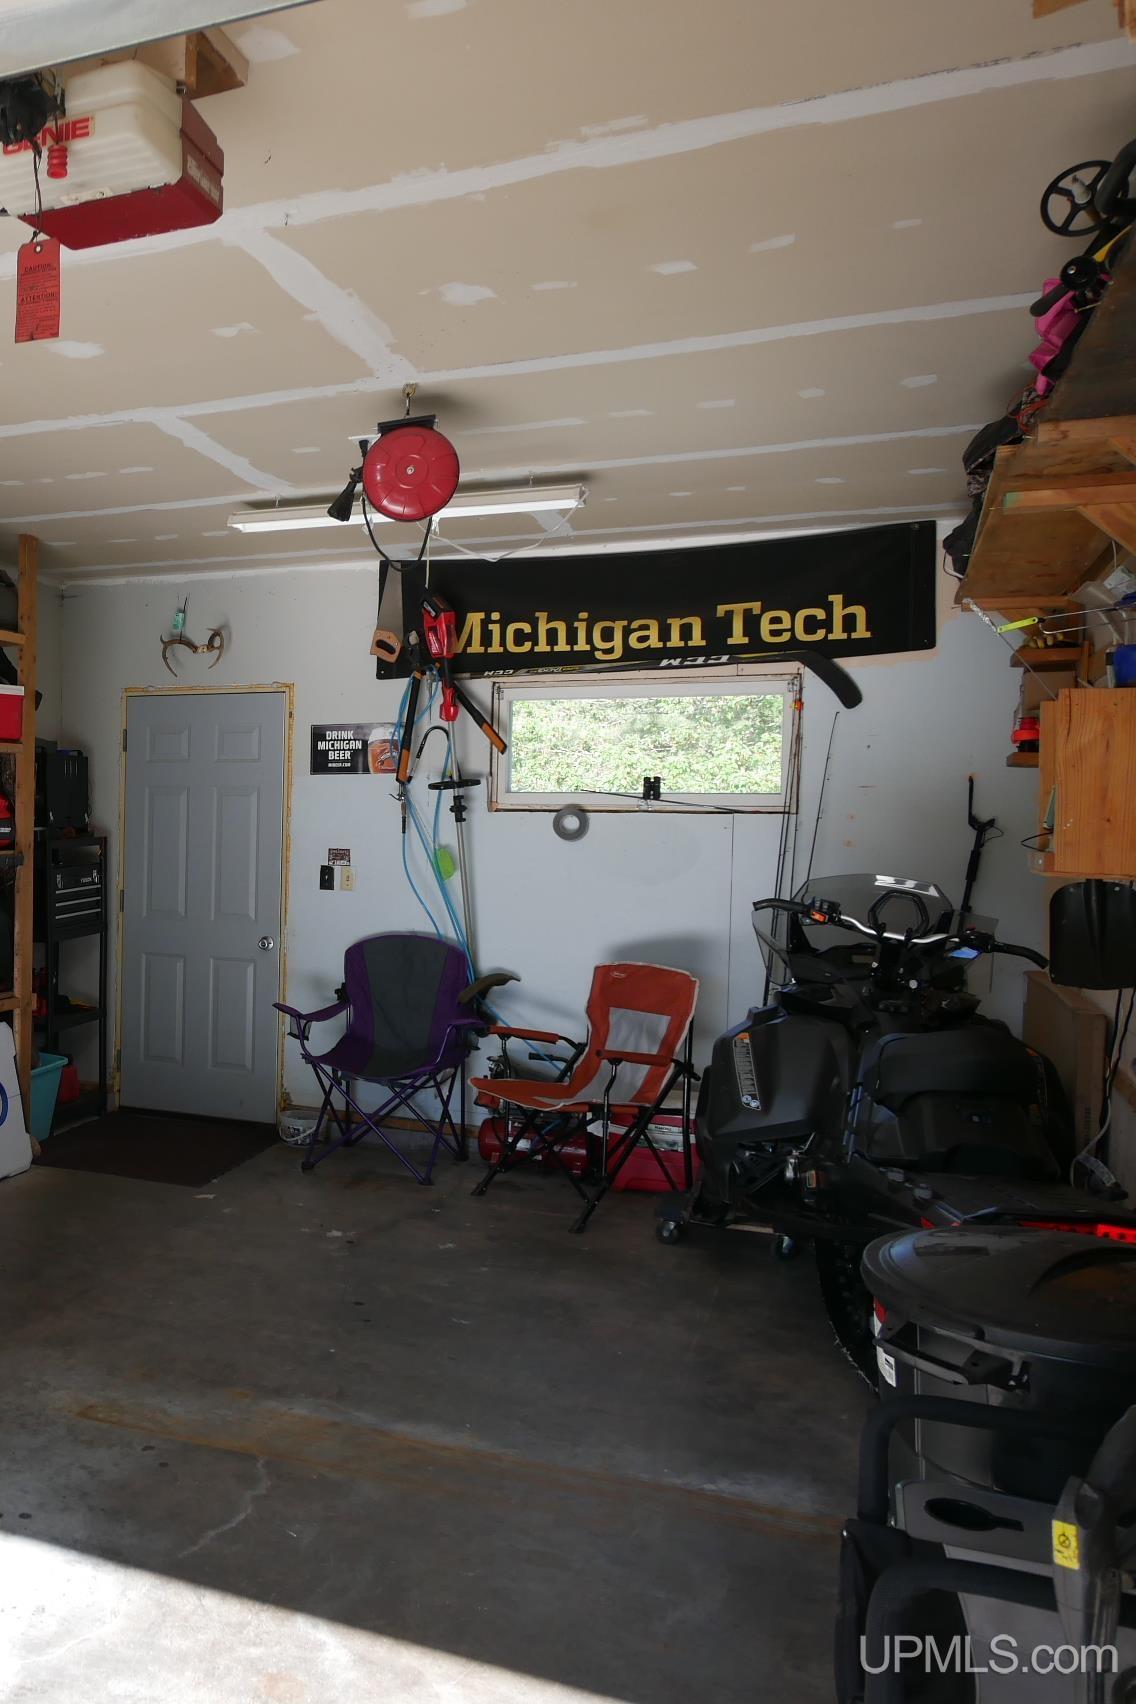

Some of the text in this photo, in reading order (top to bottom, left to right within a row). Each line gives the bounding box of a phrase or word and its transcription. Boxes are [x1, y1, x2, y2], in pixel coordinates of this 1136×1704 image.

[716, 594, 872, 645] Tech
[326, 730, 354, 740] DRINK
[317, 740, 362, 750] MICHIGAN
[328, 750, 351, 760] BEER
